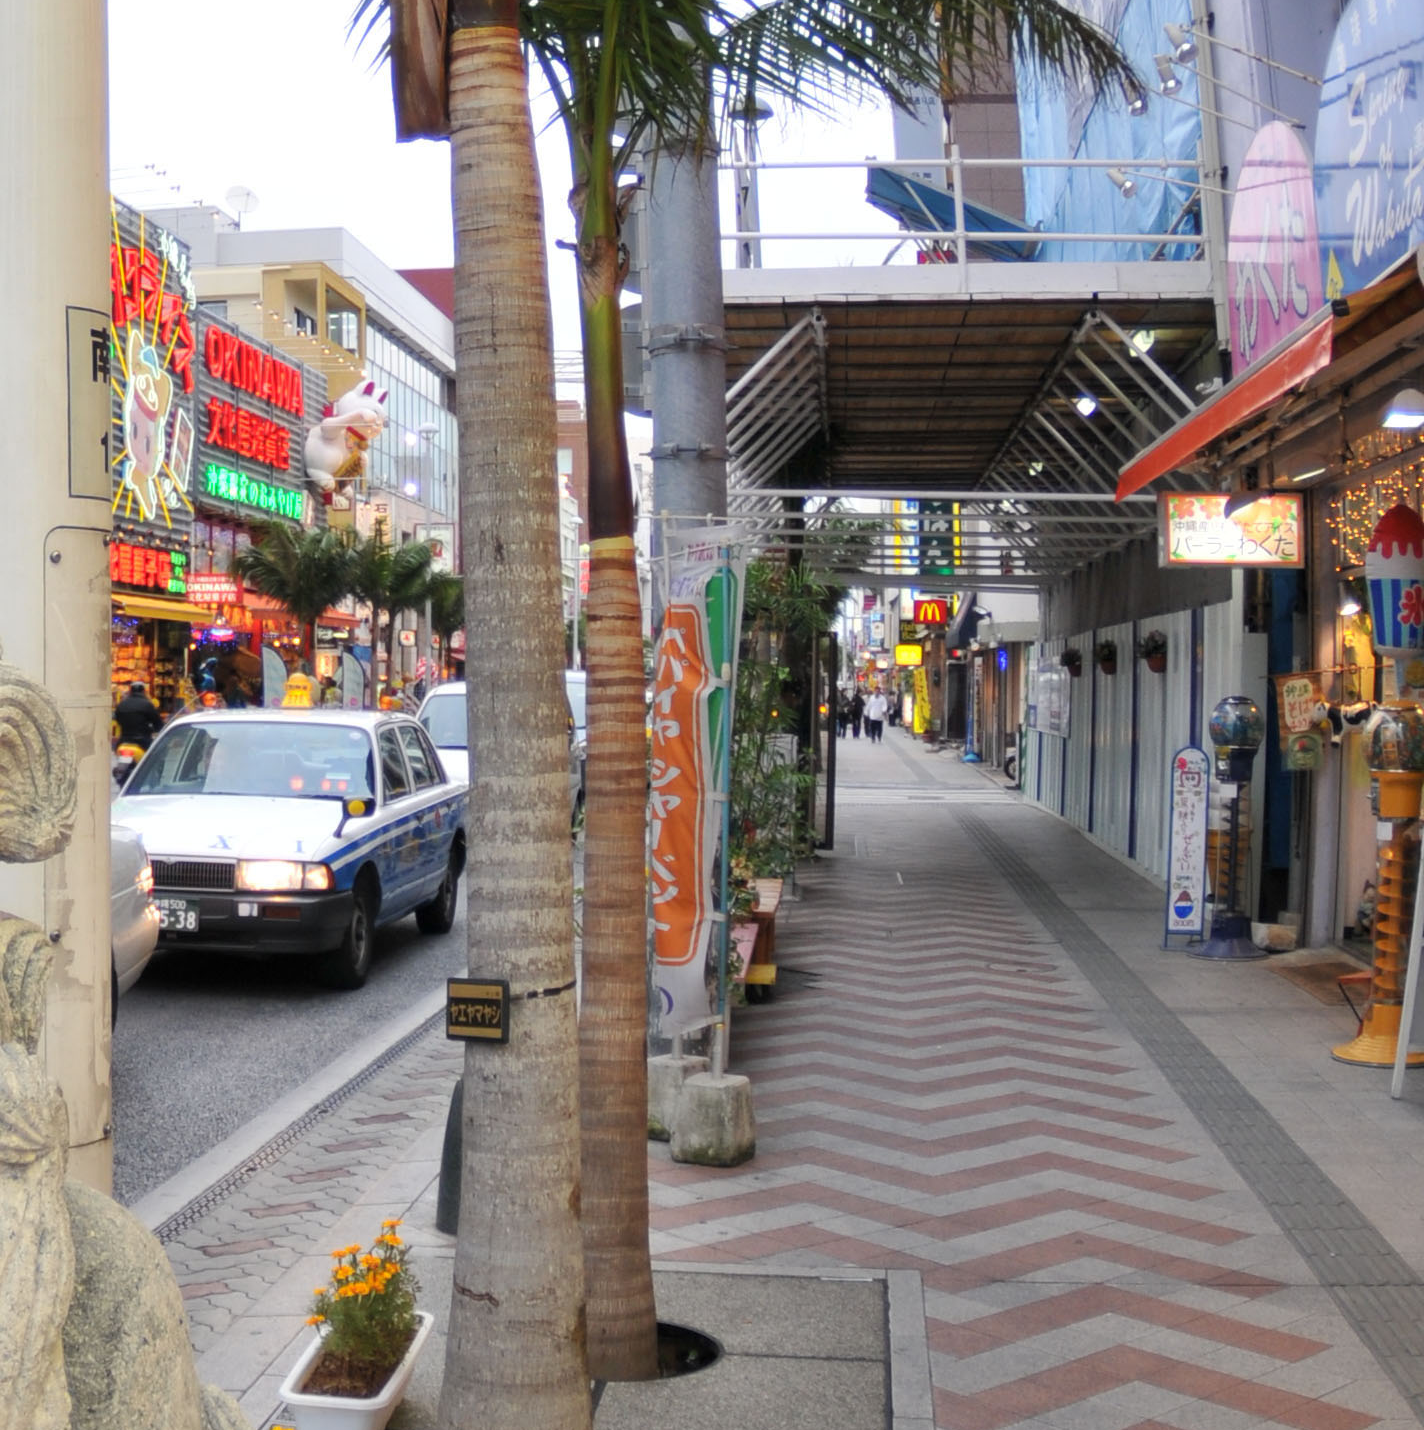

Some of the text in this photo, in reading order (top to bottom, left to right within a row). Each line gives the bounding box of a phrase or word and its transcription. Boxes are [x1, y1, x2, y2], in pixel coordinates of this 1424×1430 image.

[1347, 65, 1412, 168] Spring
[1345, 148, 1424, 268] Wakuta
[1235, 180, 1310, 365] わくた
[205, 324, 305, 418] OKINAWA
[187, 583, 238, 592] OKINAWA
[451, 1003, 501, 1025] ヤエヤマヤシ
